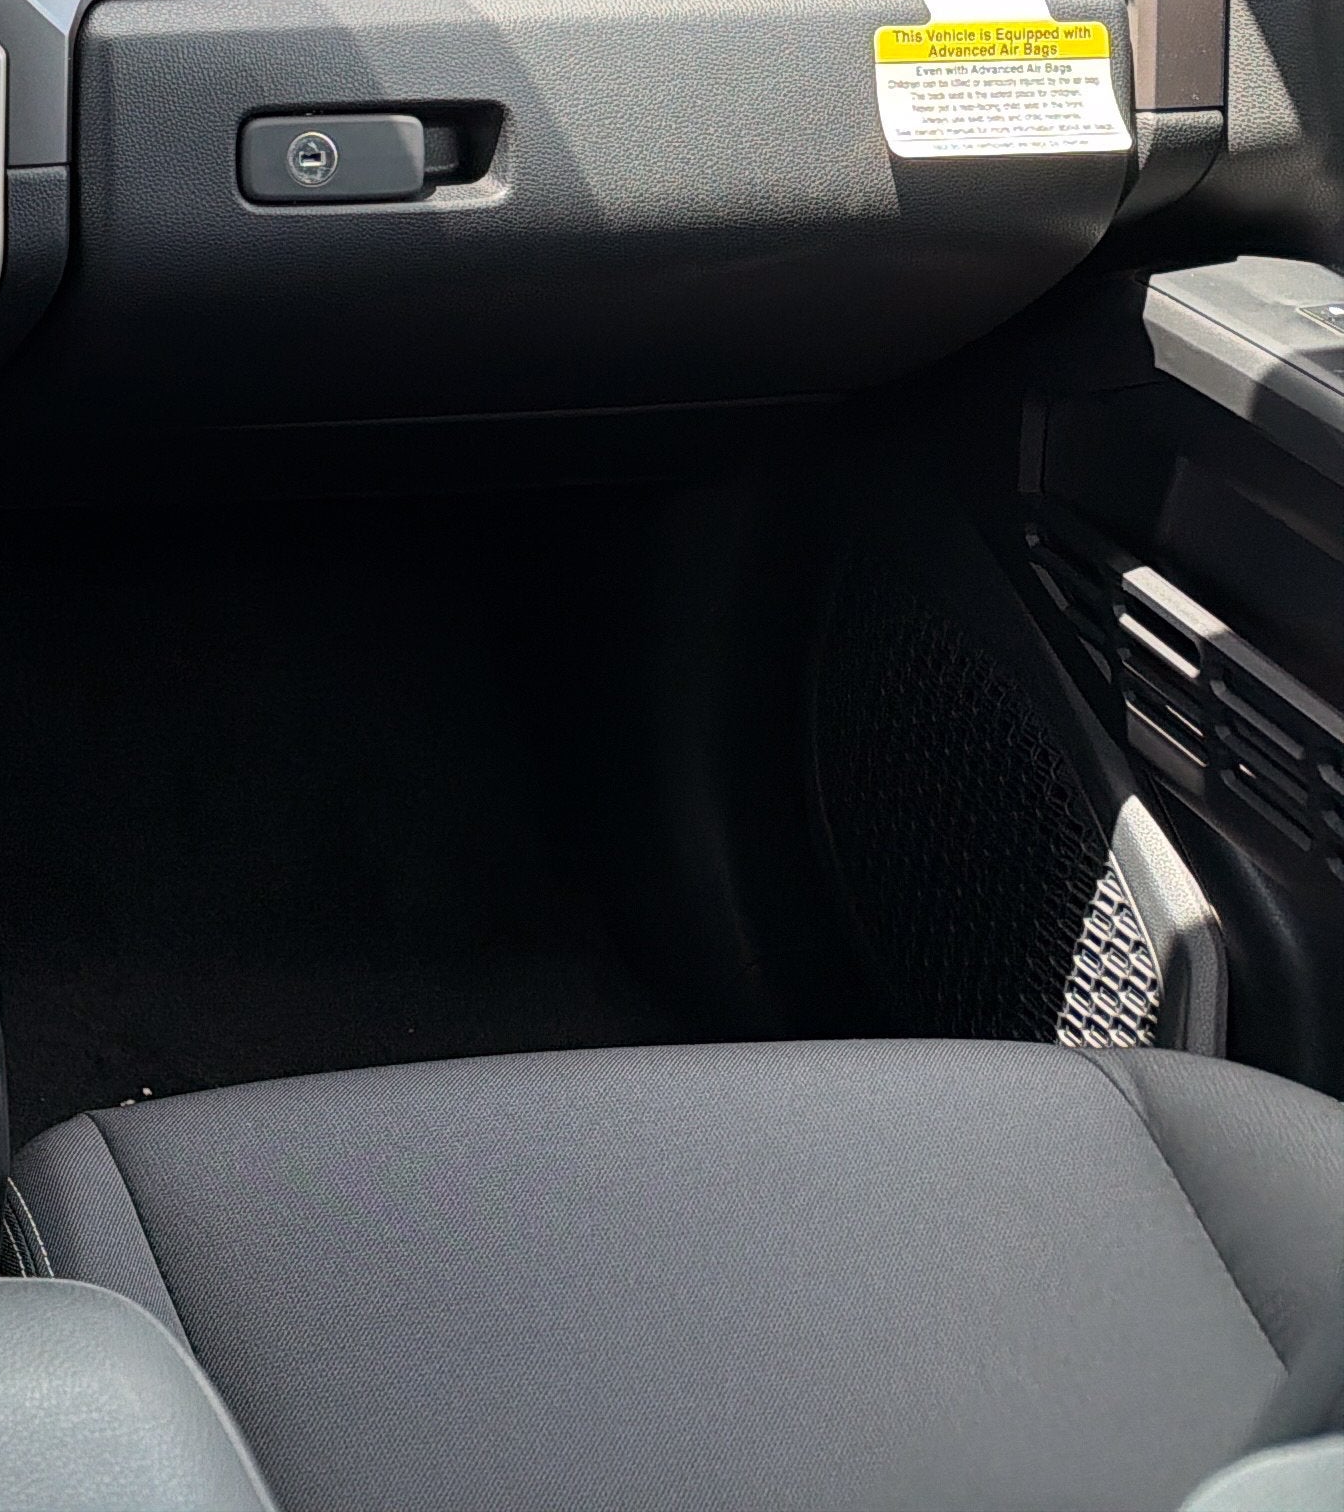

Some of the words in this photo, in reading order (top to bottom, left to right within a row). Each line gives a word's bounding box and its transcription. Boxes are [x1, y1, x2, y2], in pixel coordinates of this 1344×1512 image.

[892, 29, 923, 43] This
[926, 28, 976, 42] Vehicle
[979, 28, 991, 41] is
[995, 27, 1060, 42] Equipped
[1063, 26, 1092, 39] with
[928, 43, 996, 58] Advanced
[999, 43, 1019, 56] Air
[1023, 42, 1058, 58] Bags
[916, 65, 943, 76] Even
[946, 64, 968, 75] with
[971, 64, 1023, 75] Advanced
[1026, 63, 1041, 74] Air
[1045, 62, 1072, 75] Bags
